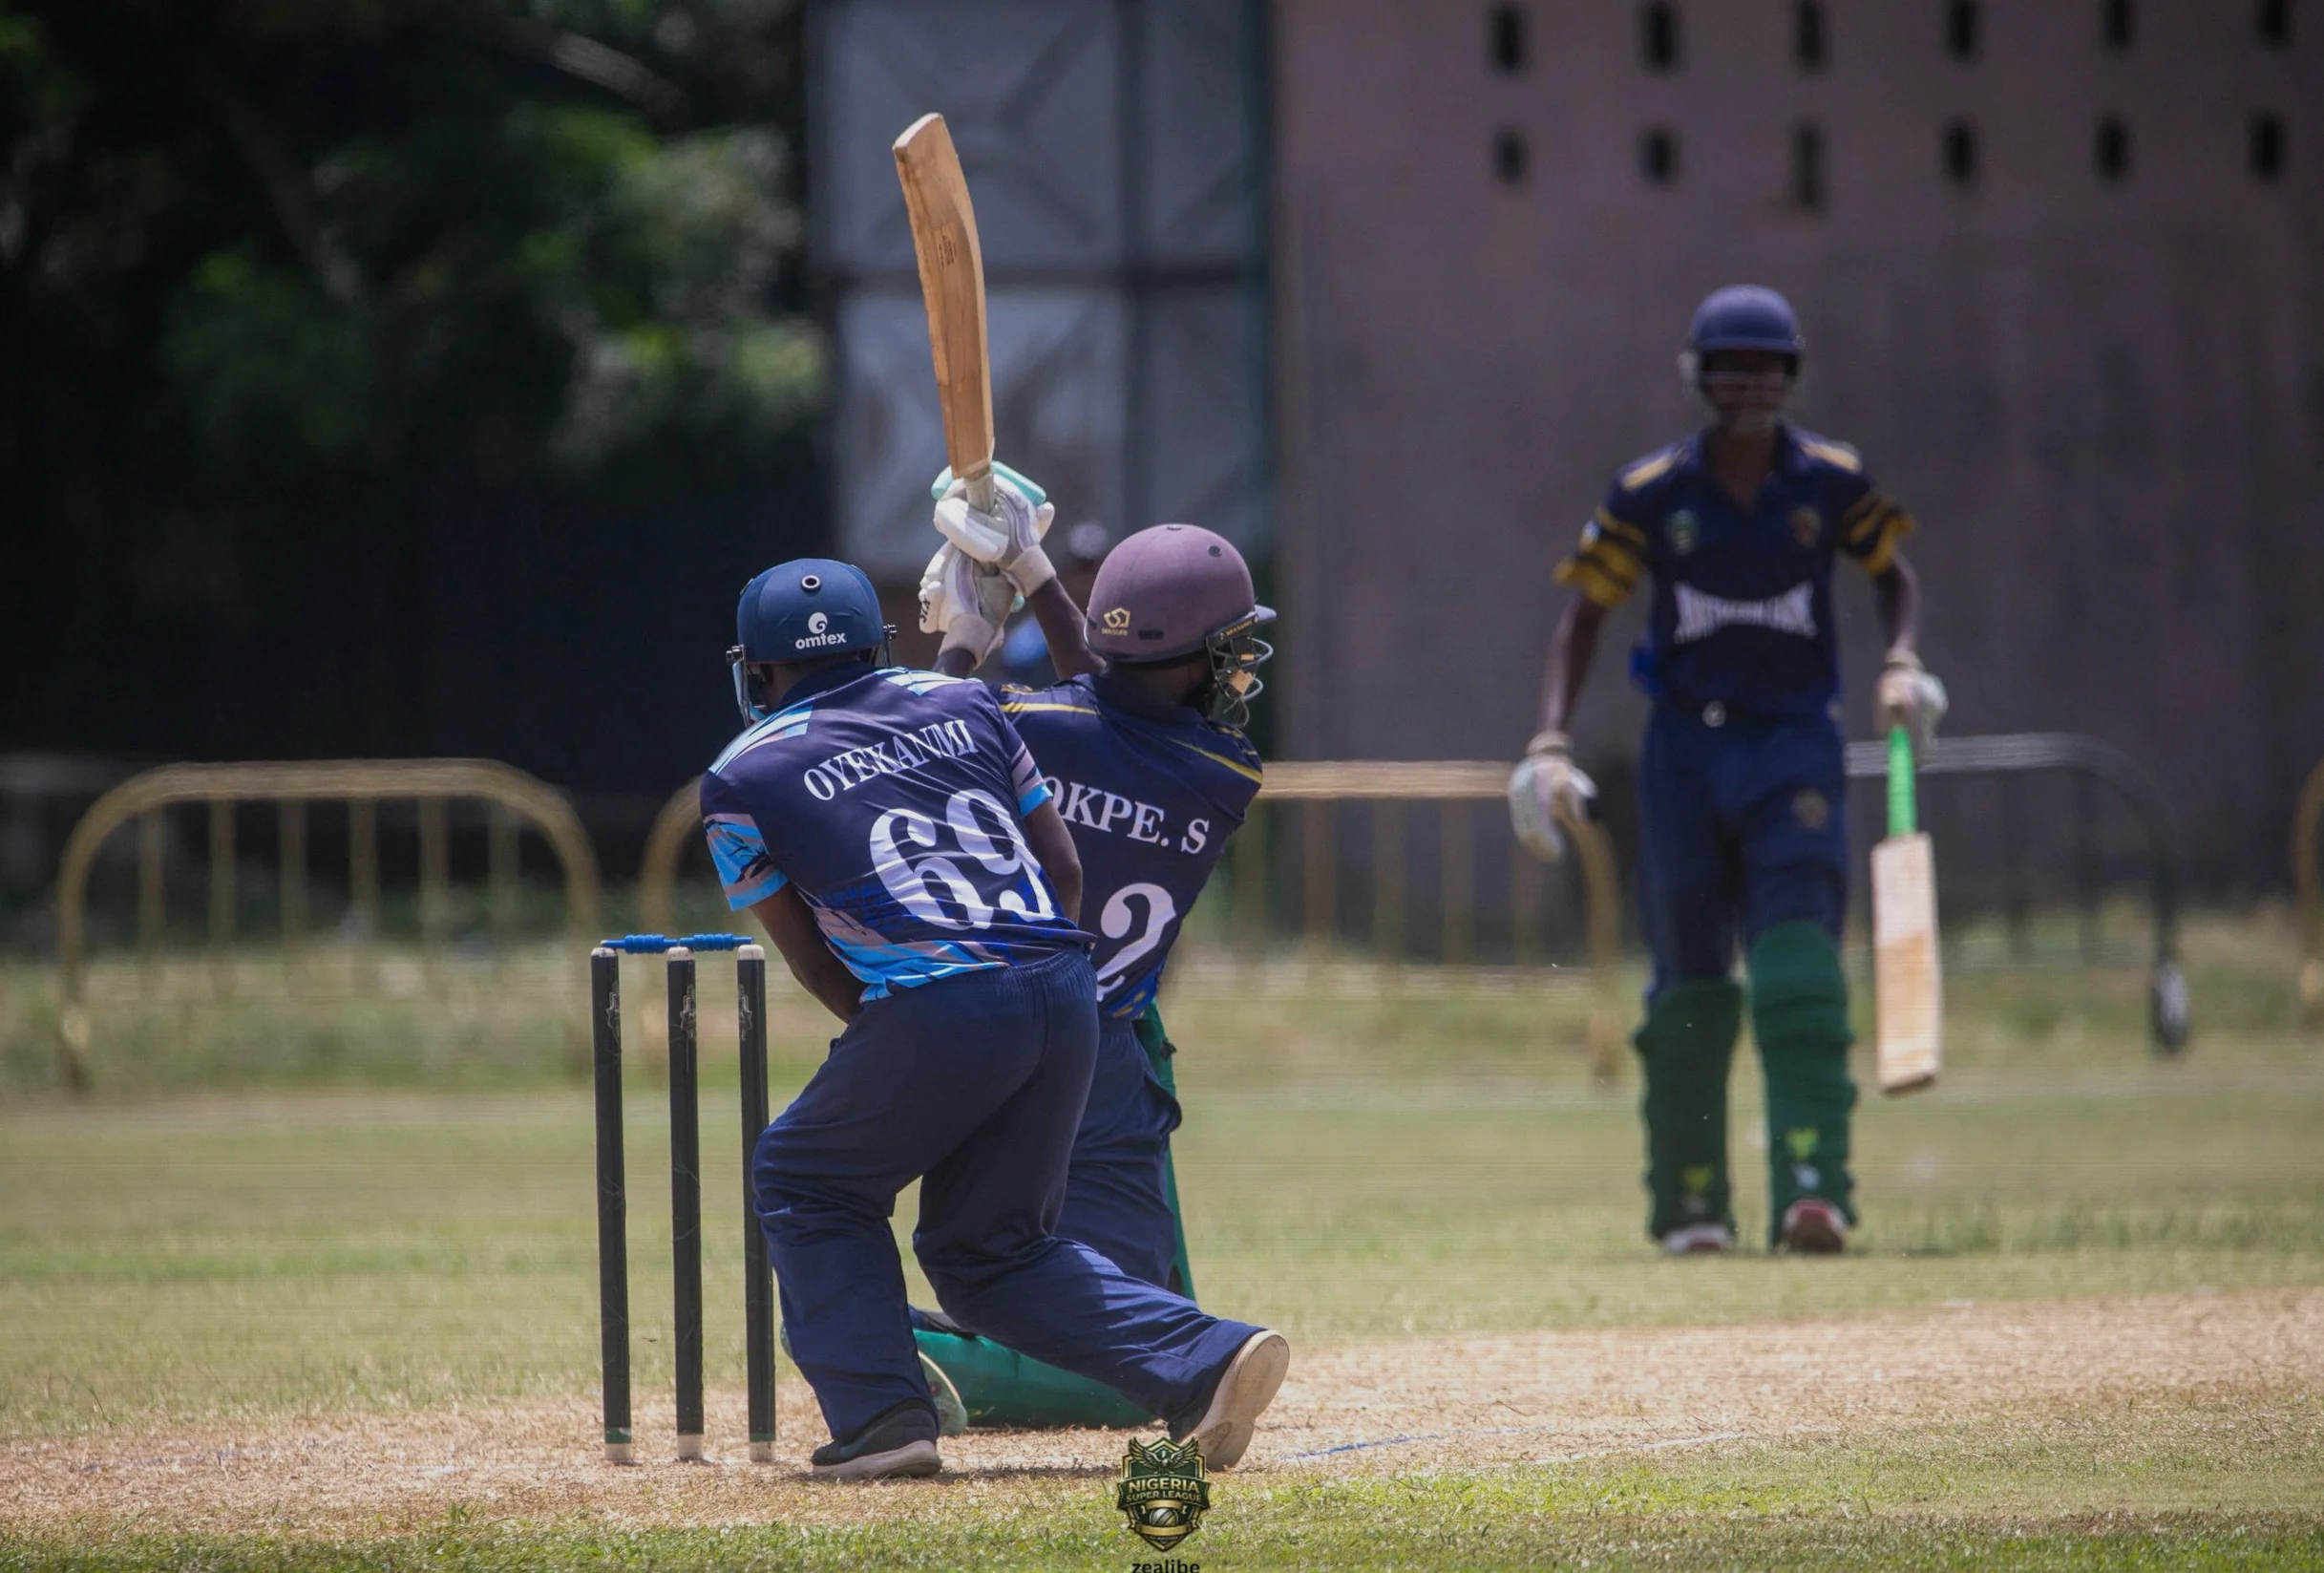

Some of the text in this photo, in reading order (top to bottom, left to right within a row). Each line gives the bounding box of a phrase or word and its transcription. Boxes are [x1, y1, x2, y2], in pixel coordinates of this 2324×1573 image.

[795, 632, 847, 649] omtex
[803, 719, 979, 801] OYEKANMI
[869, 788, 1056, 931] 69
[1180, 818, 1210, 854] S
[1096, 882, 1176, 1002] 2
